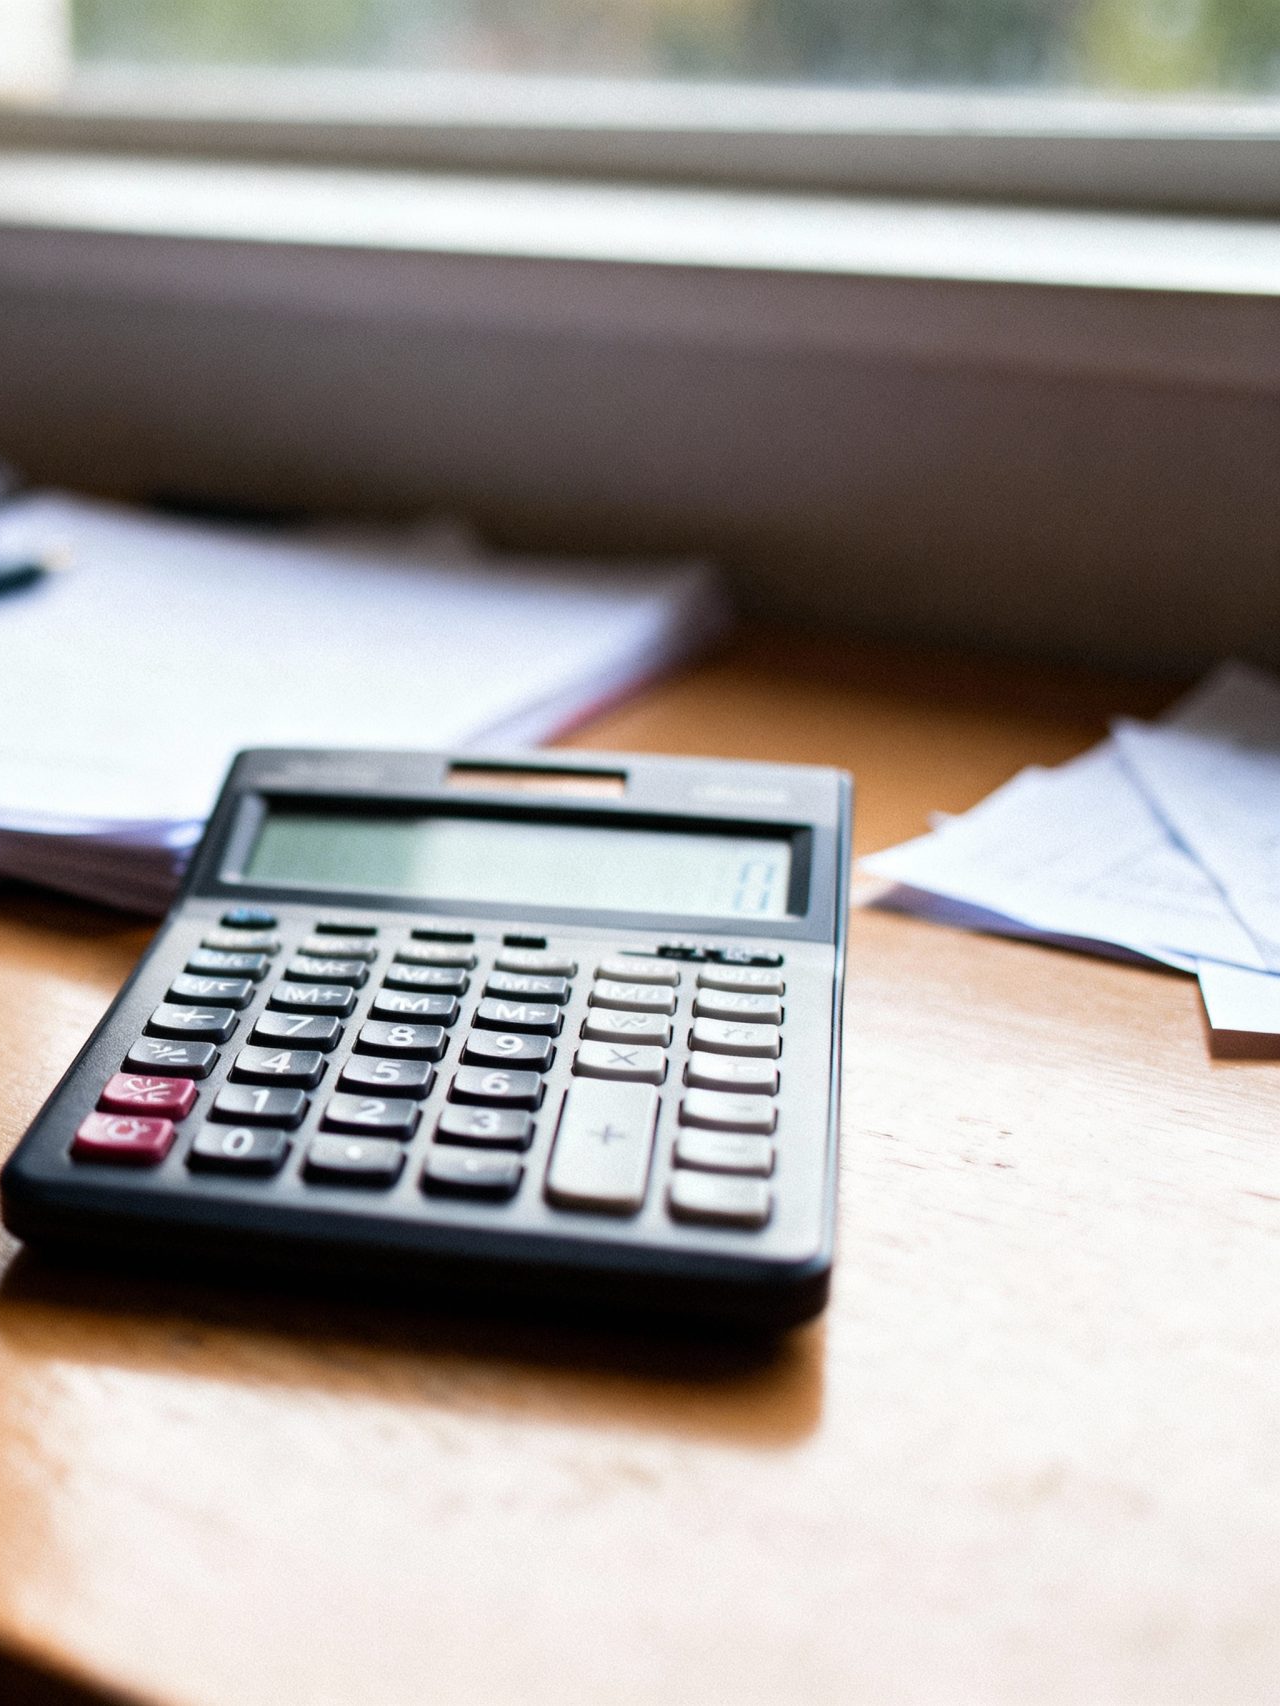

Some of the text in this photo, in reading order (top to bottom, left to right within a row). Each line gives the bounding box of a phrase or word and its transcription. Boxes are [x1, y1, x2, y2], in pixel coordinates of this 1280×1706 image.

[286, 1015, 314, 1036] 7
[387, 1025, 416, 1046] 8
[496, 1035, 524, 1055] 9
[260, 1052, 292, 1075] 4
[372, 1062, 400, 1083] 5
[481, 1073, 510, 1094] 6
[252, 1089, 271, 1112] 1
[358, 1100, 387, 1121] 2
[471, 1111, 500, 1132] 3
[222, 1128, 254, 1156] 0
